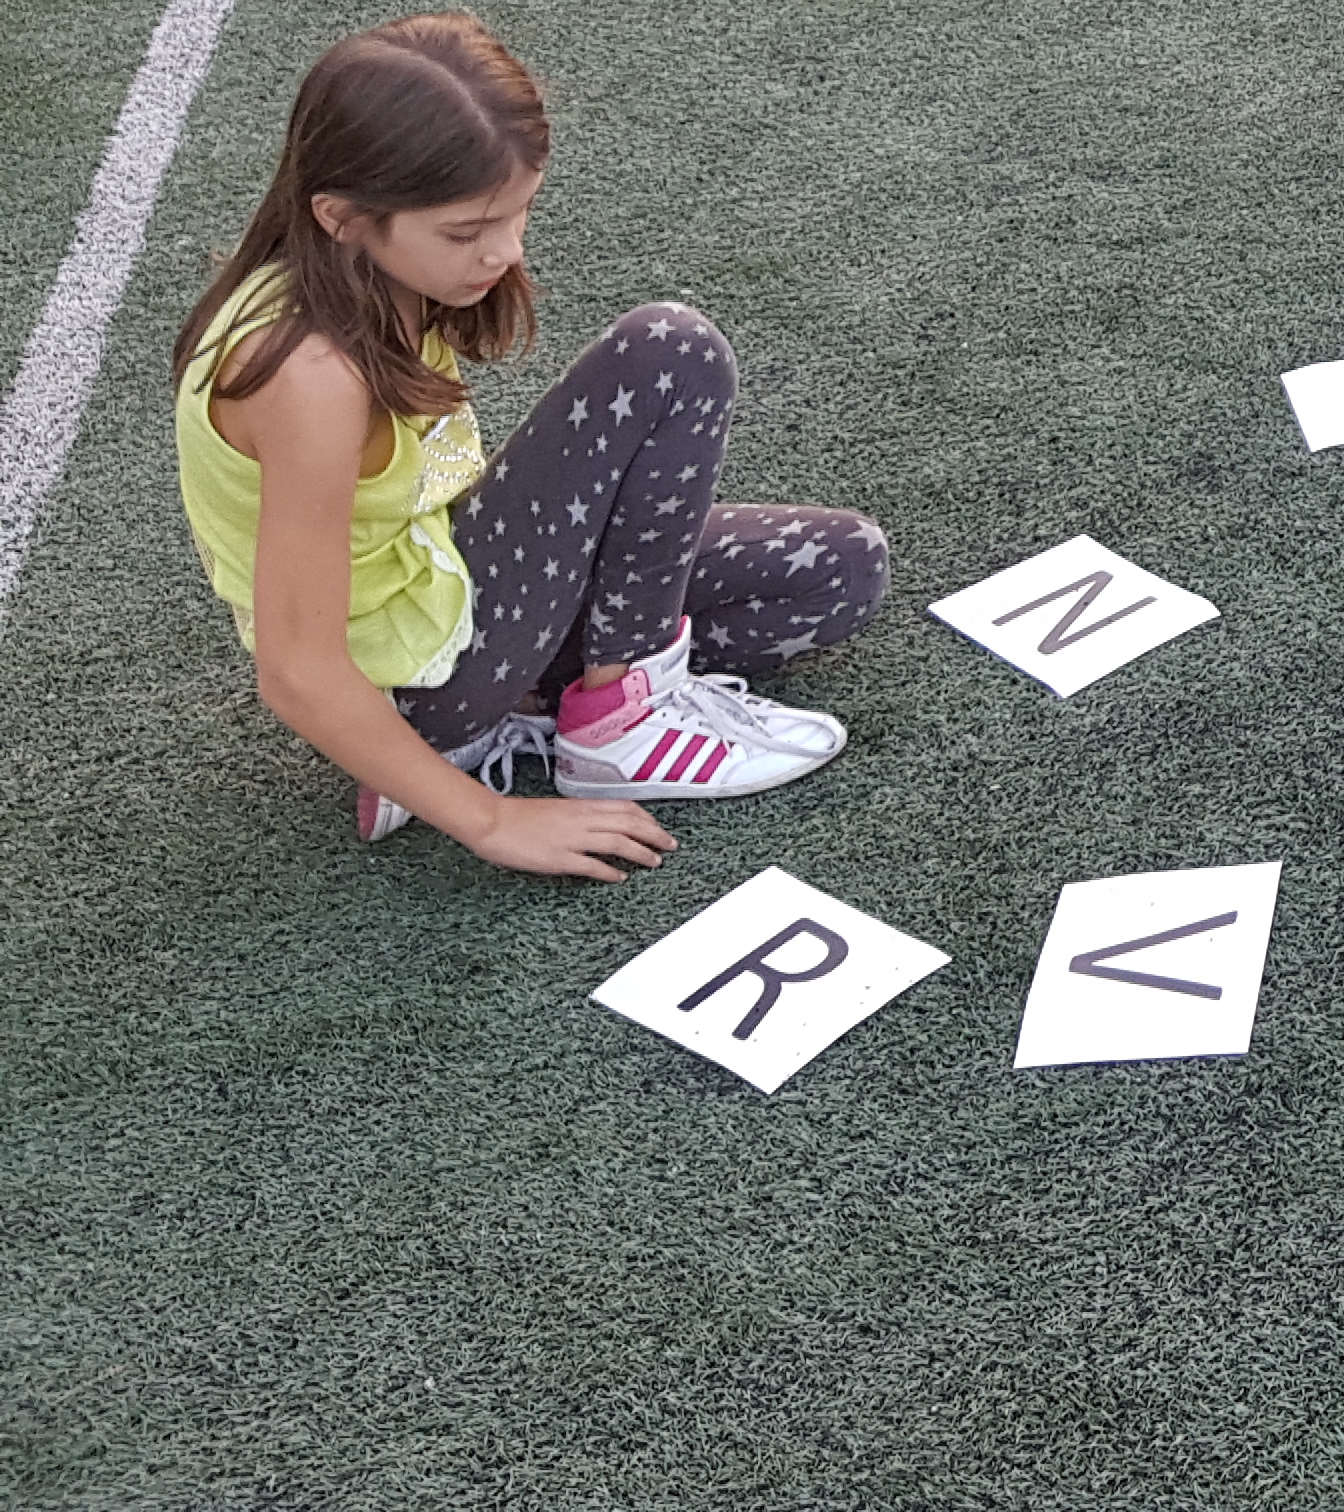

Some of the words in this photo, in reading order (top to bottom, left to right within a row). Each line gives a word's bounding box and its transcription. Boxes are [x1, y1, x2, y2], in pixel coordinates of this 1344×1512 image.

[992, 571, 1157, 655] N
[677, 917, 849, 1041] R
[1068, 911, 1238, 1001] V
